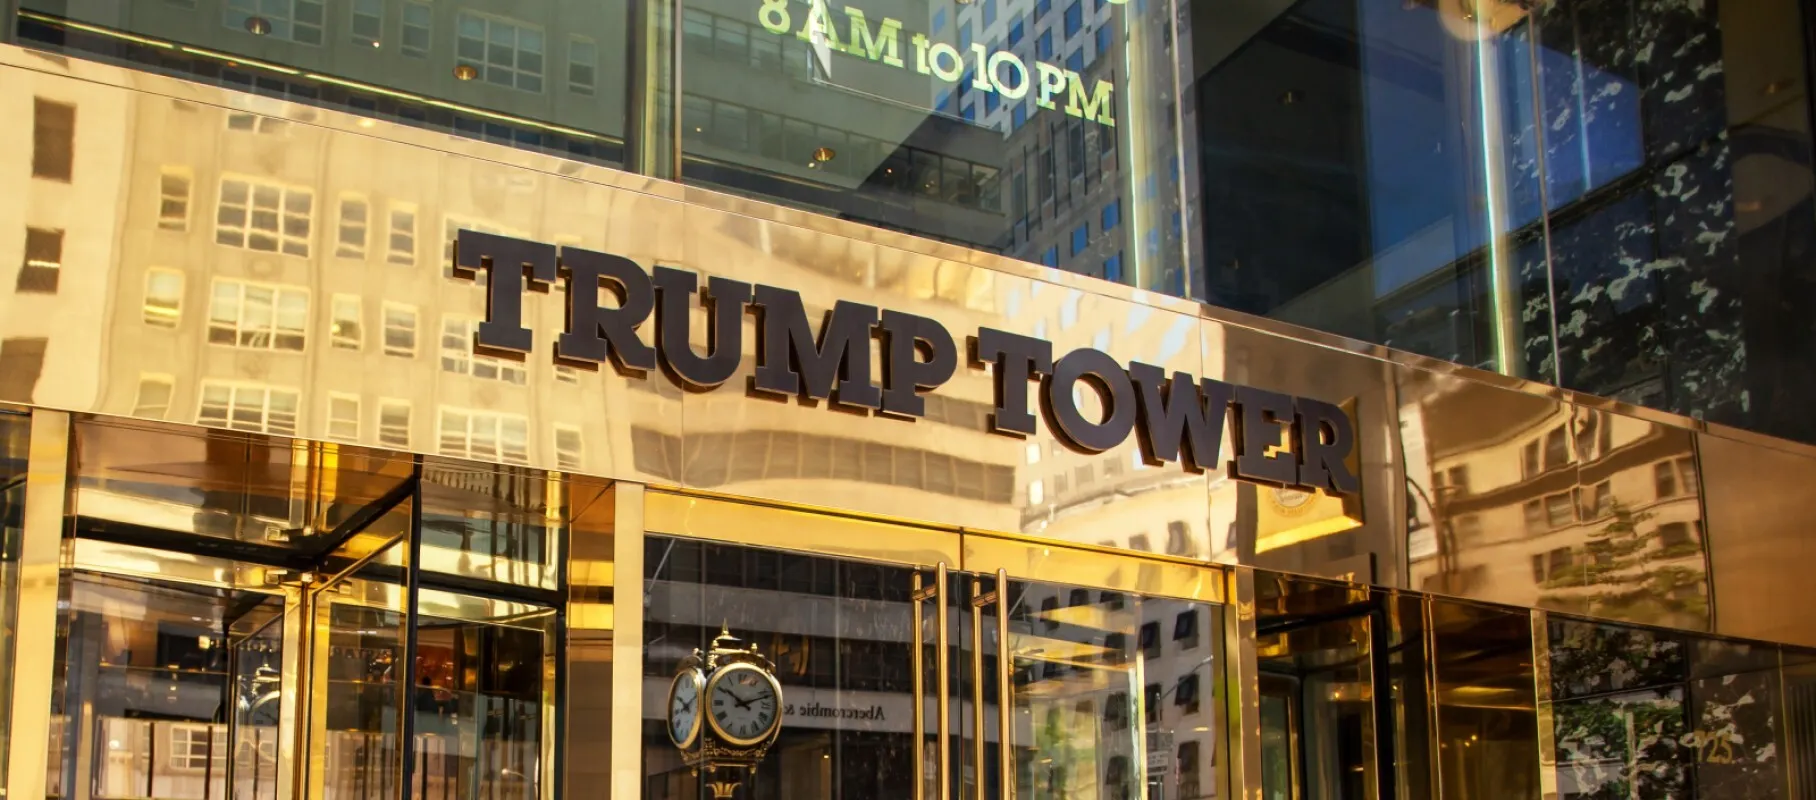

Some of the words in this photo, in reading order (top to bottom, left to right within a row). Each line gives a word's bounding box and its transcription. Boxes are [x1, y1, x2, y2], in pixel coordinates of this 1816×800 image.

[758, 0, 791, 35] 8
[796, 0, 904, 68] AM
[912, 32, 964, 83] to
[971, 42, 1030, 100] 10
[1035, 61, 1115, 127] PM
[454, 228, 958, 420] TRUMP
[968, 326, 1358, 497] TOWER
[1693, 729, 1734, 764] 725
